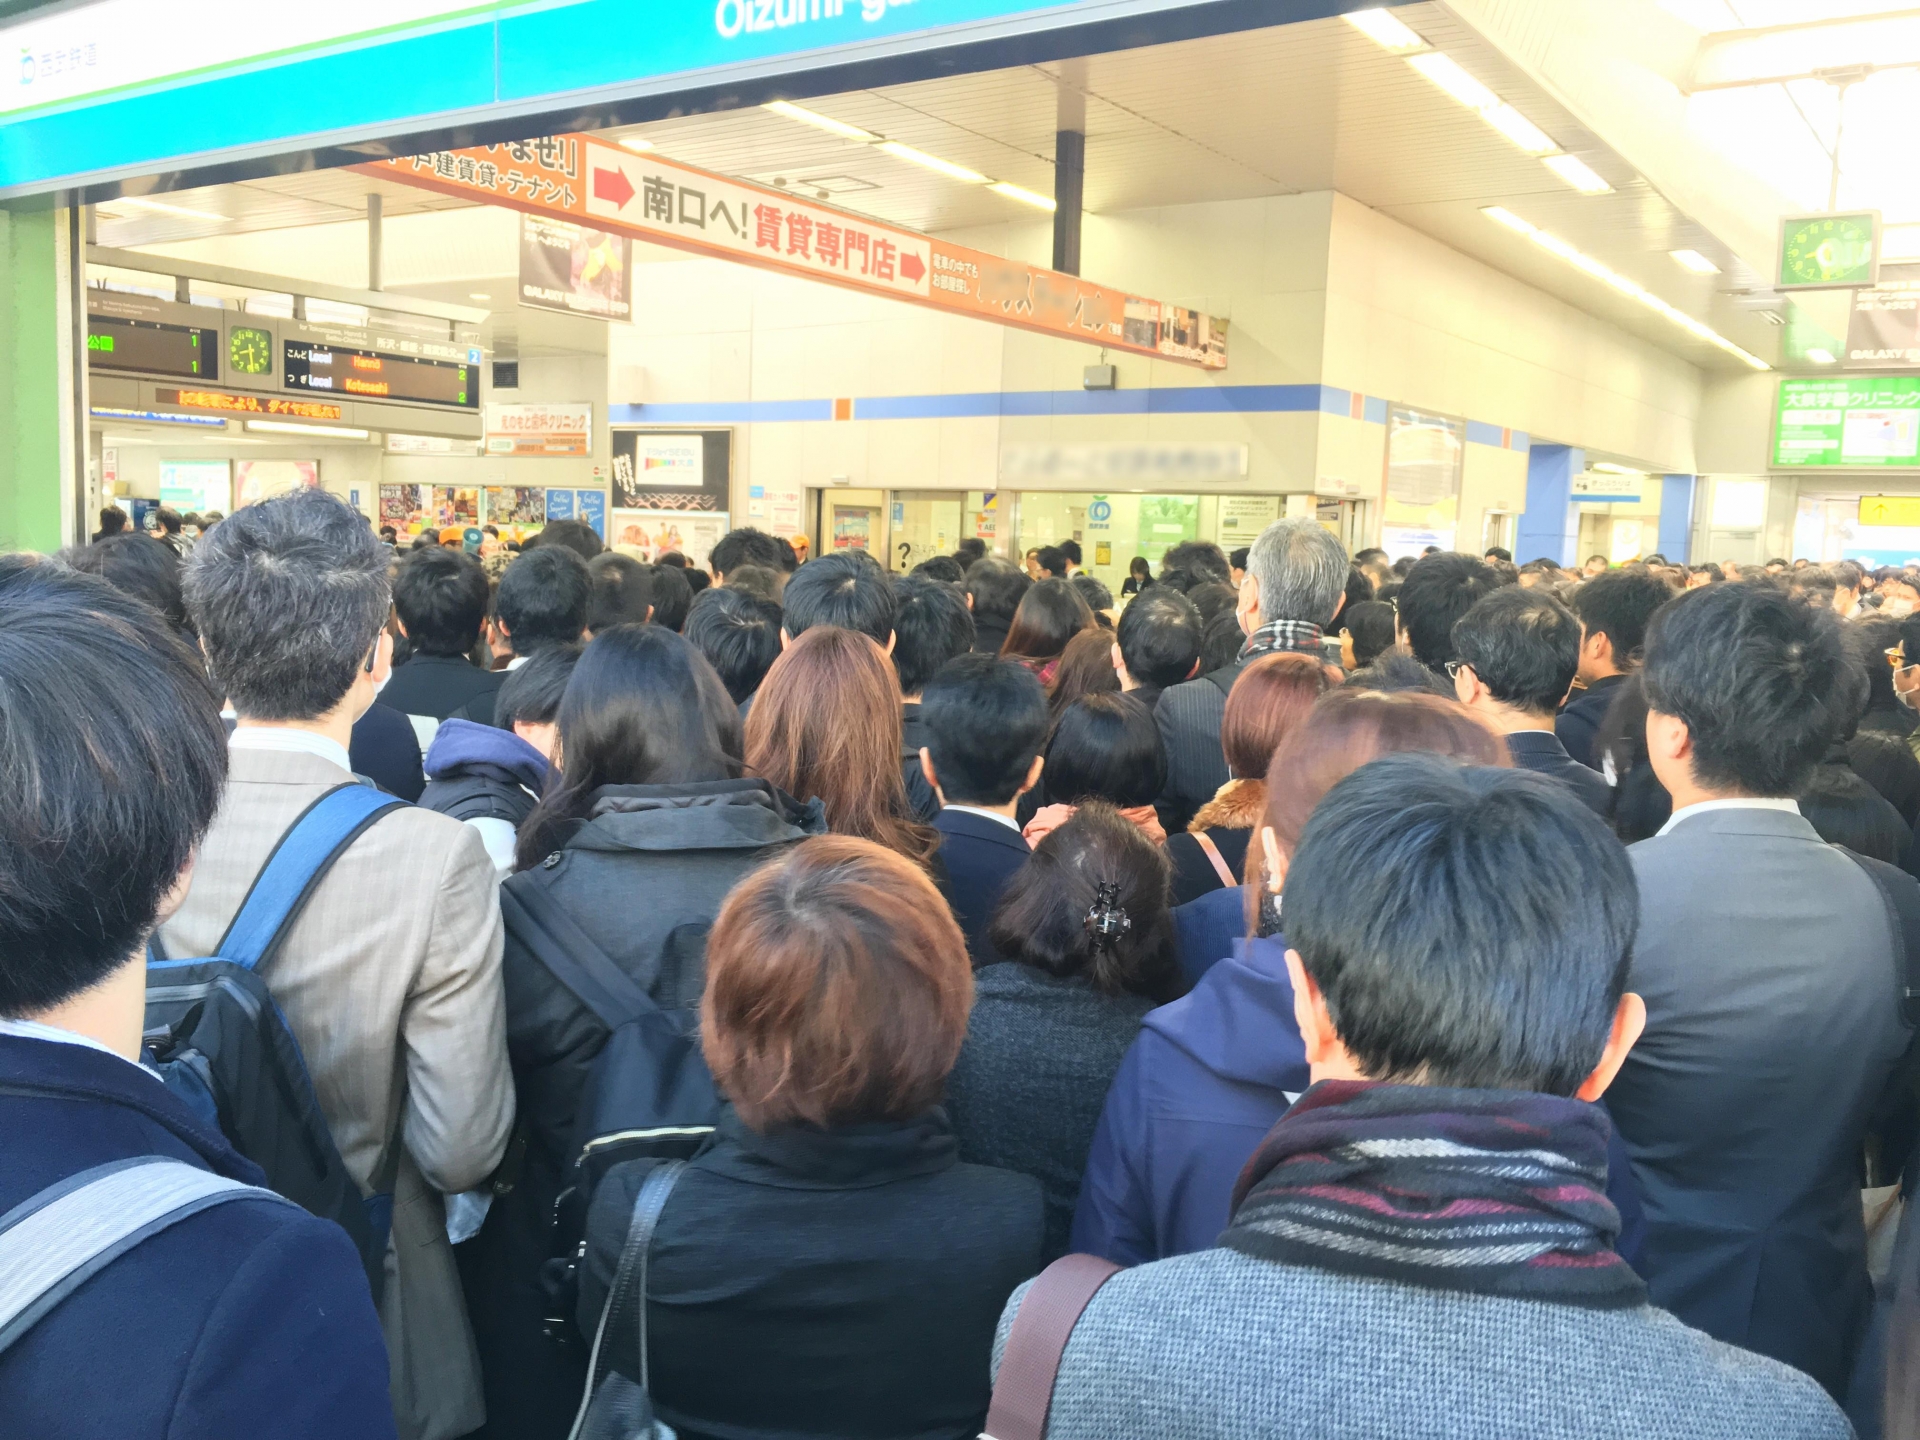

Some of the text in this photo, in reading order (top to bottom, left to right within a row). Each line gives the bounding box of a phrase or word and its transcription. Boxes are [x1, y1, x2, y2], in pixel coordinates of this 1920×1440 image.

[932, 253, 978, 279] 電車の中でも
[931, 273, 971, 295] お部屋探し
[191, 335, 197, 347] 1
[470, 351, 480, 363] 2
[1850, 349, 1905, 360] GALAXY
[191, 360, 197, 373] 1
[287, 349, 307, 360] こんど
[308, 350, 332, 364] Local
[458, 370, 466, 381] 2
[308, 374, 333, 388] Local
[458, 393, 466, 404] 2
